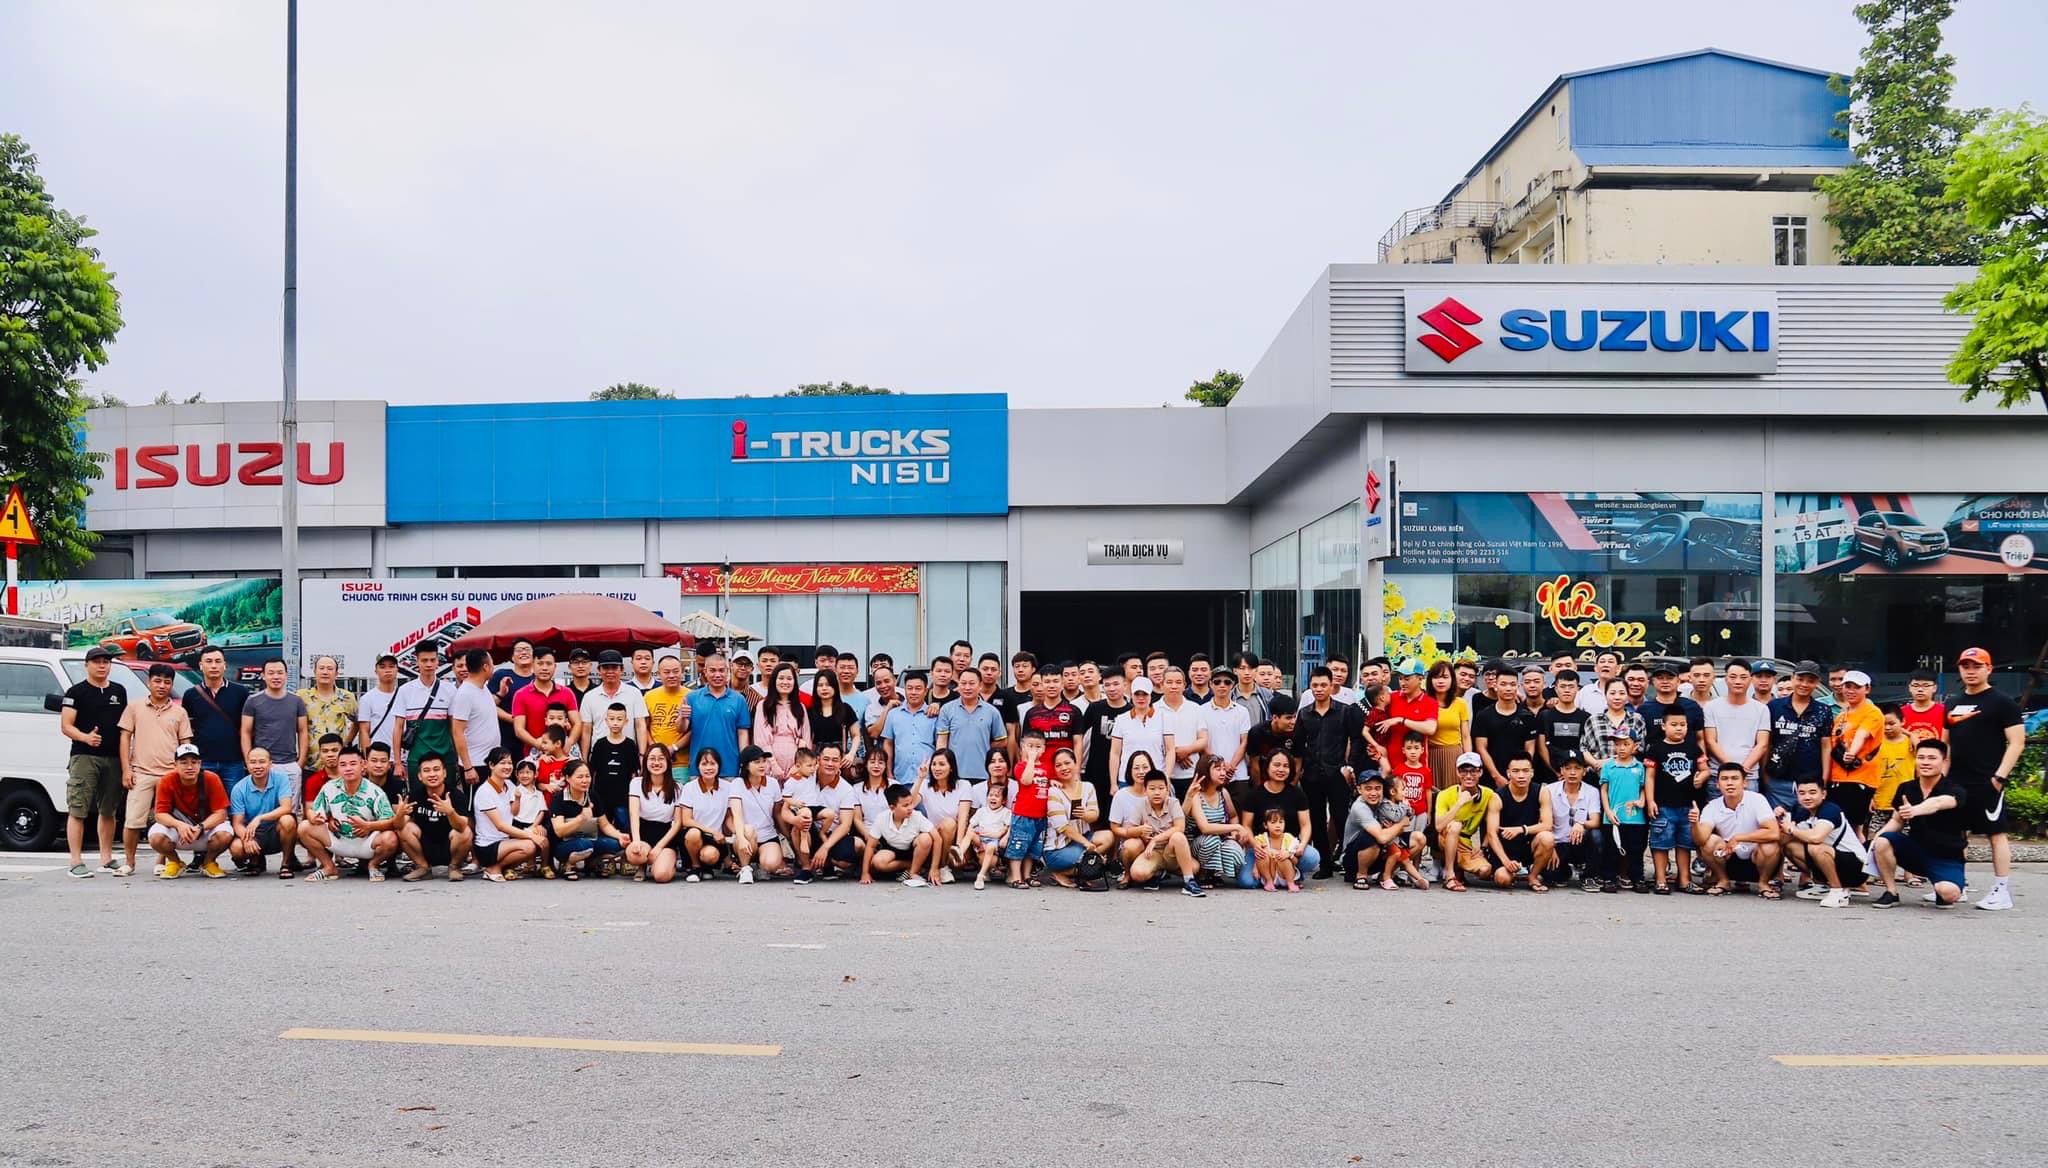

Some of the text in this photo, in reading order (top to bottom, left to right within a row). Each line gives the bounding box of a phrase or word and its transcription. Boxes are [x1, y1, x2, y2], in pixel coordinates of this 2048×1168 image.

[1500, 309, 1770, 352] SUZUKI
[115, 442, 345, 490] ISUZU
[851, 461, 950, 485] NISU
[1796, 513, 1823, 524] XL7
[1980, 511, 2002, 519] CHO
[1793, 527, 1832, 542] 1.5 AT
[1104, 544, 1168, 559] TRẠM DỊCH VỤ
[2005, 551, 2029, 561] Triệu
[342, 583, 383, 591] ISUZU
[420, 593, 448, 601] CSKH
[390, 607, 459, 654] ISUZU CARE
[1576, 621, 1647, 648] 2022
[1405, 775, 1421, 787] SUP
